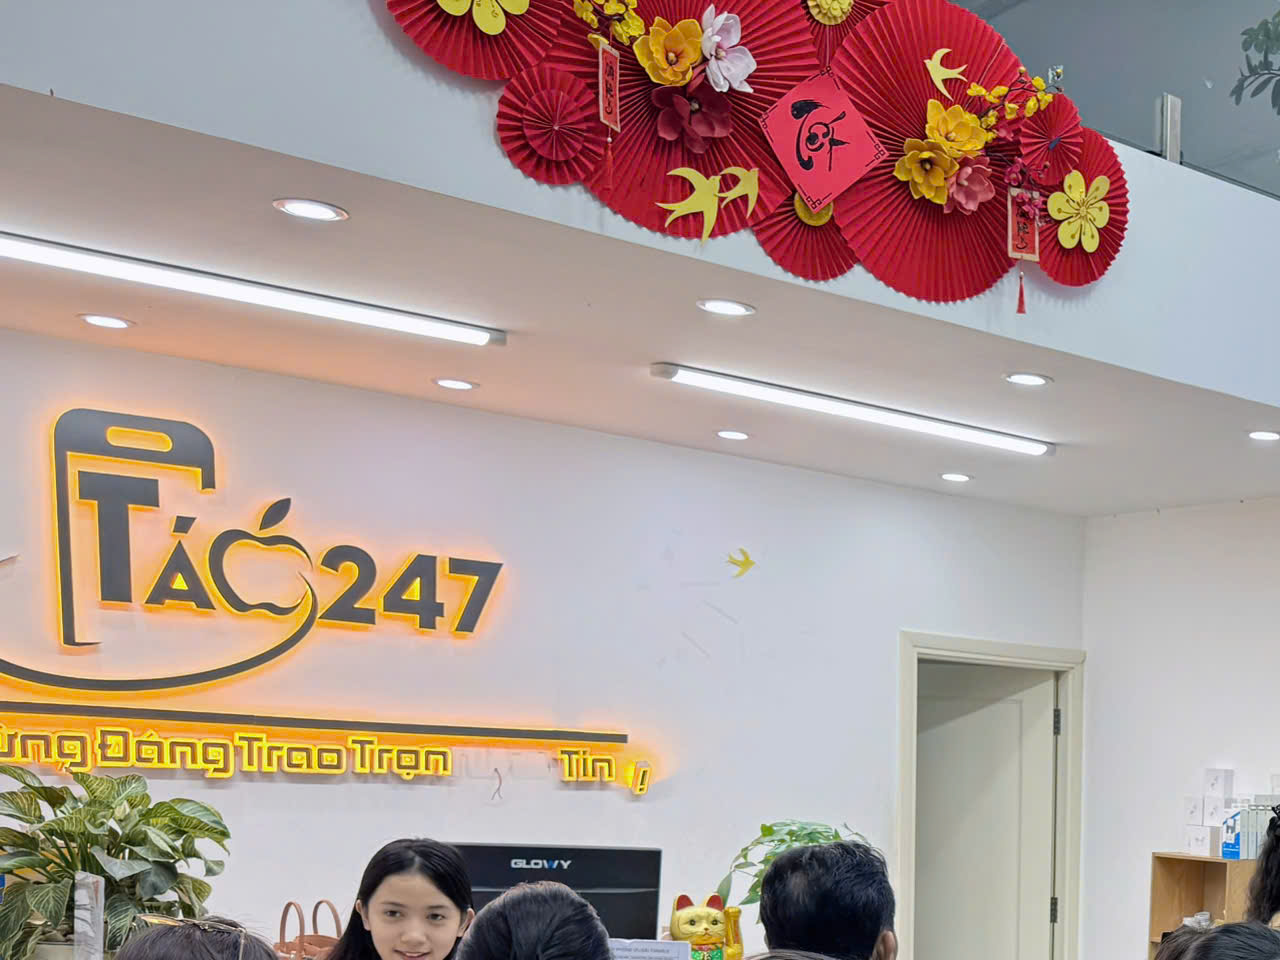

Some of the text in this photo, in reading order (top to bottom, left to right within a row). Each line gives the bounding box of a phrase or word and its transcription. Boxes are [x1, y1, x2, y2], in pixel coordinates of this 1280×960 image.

[96, 727, 236, 779] Đáng
[236, 732, 347, 775] Trao
[348, 736, 453, 781] Trọn
[558, 748, 617, 783] Tin
[510, 858, 572, 869] GLOWY
